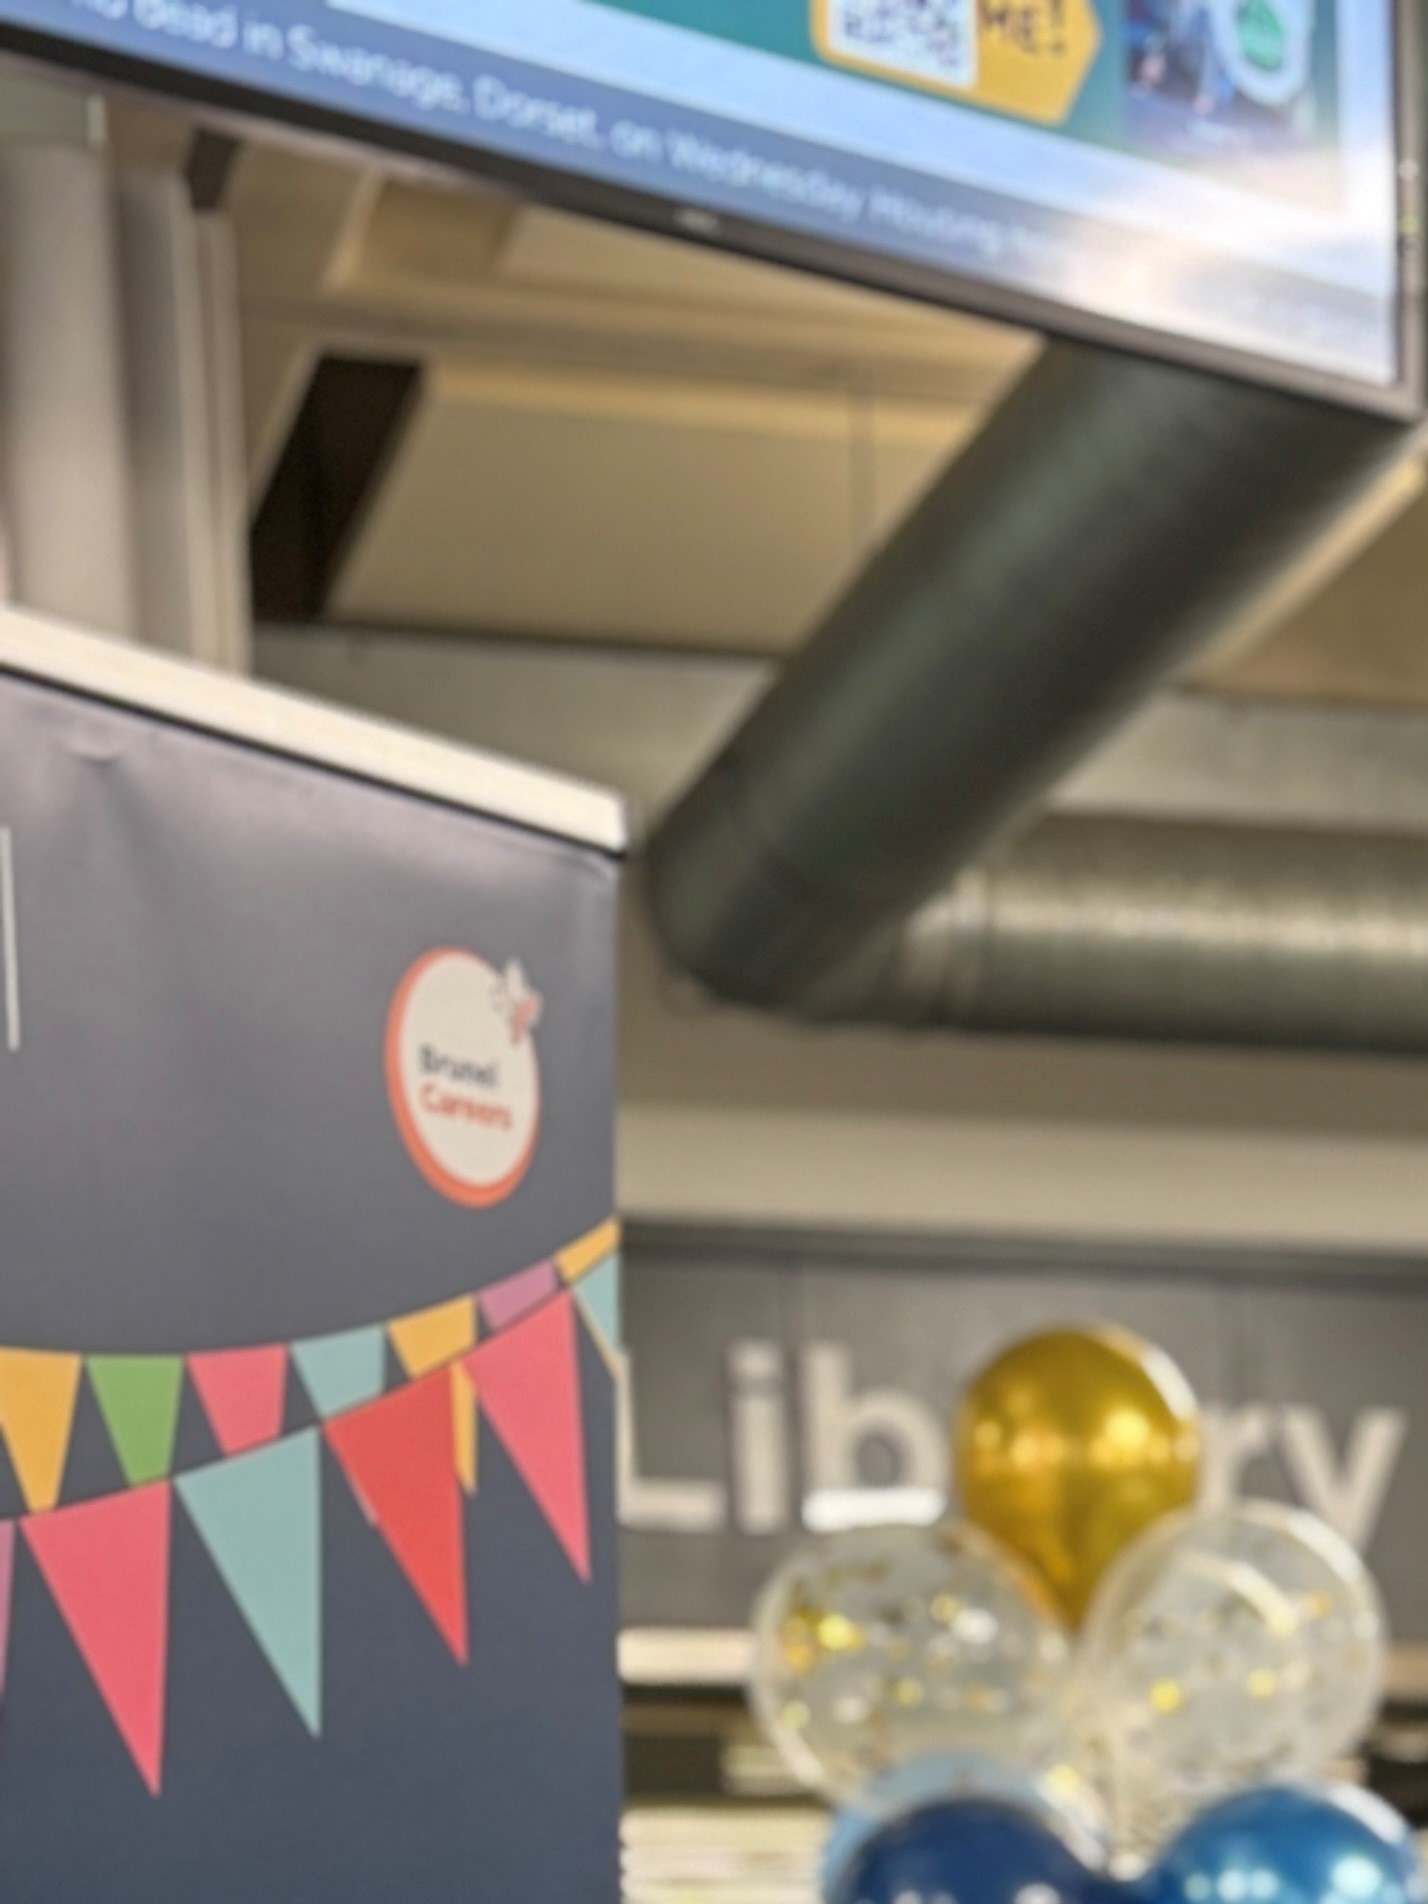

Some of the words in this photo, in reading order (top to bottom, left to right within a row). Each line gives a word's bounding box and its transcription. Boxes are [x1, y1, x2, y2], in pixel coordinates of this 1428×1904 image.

[287, 24, 472, 116] Swanage,
[473, 73, 602, 150] Dorset,
[611, 116, 661, 164] on
[671, 128, 865, 222] Wednesday
[615, 1340, 1407, 1556] Libry
